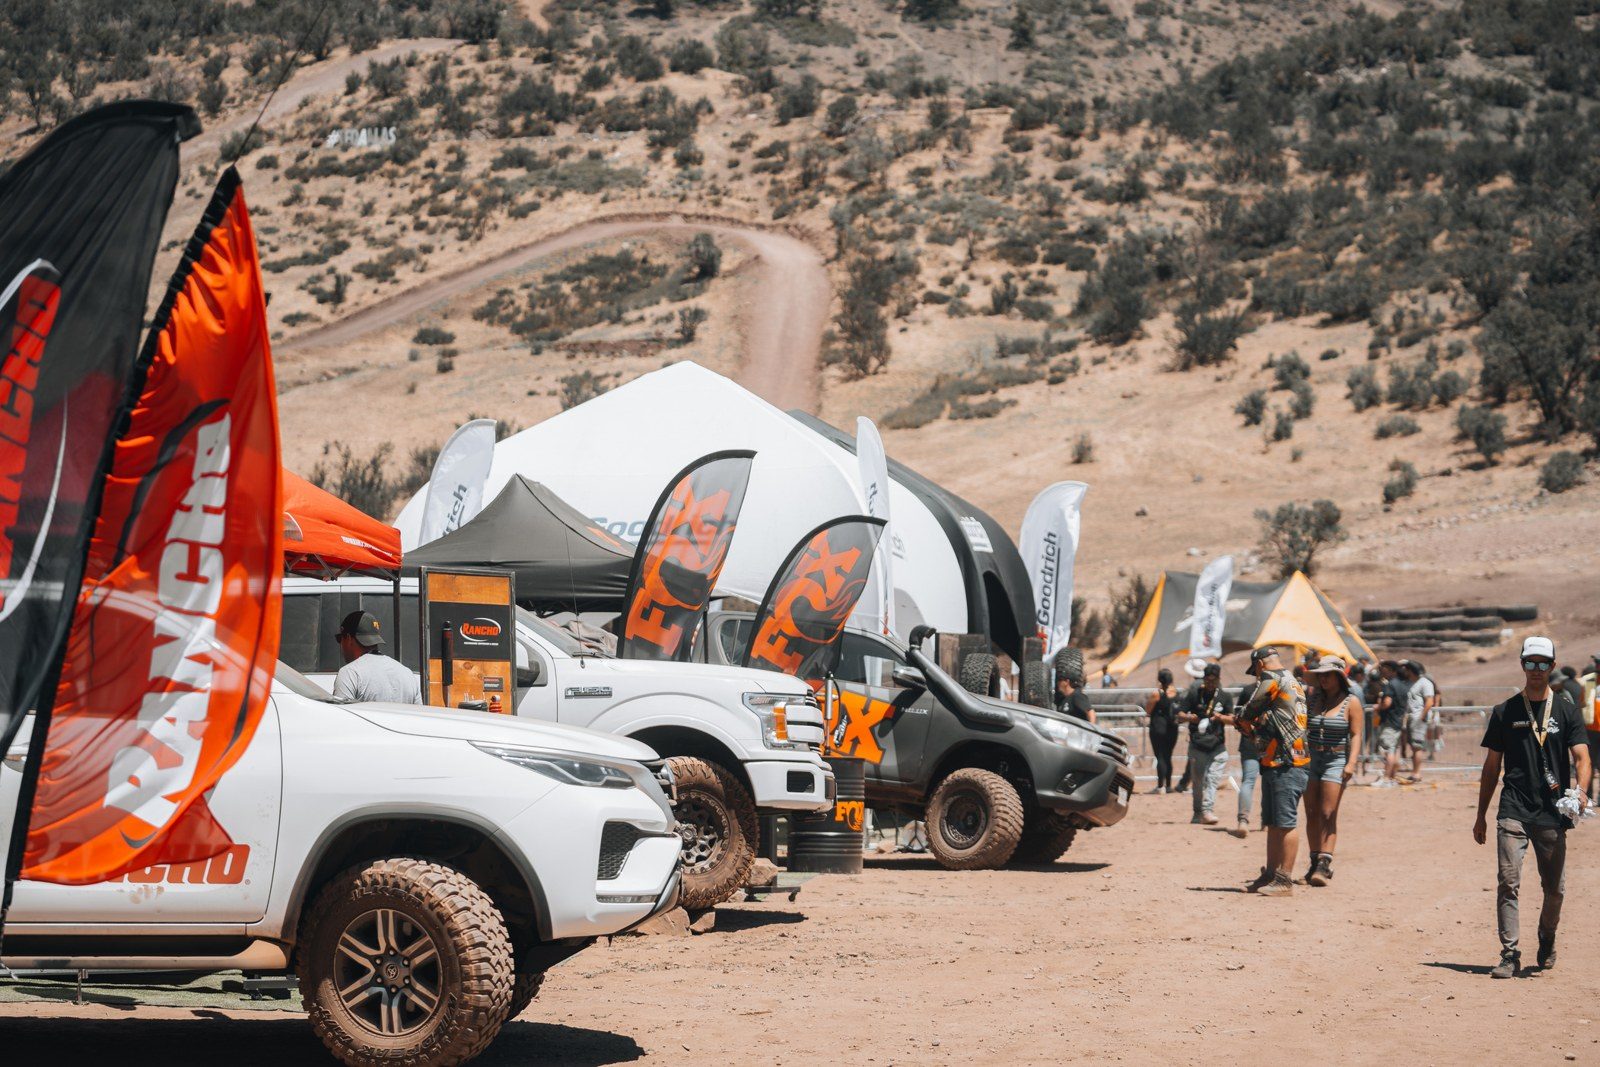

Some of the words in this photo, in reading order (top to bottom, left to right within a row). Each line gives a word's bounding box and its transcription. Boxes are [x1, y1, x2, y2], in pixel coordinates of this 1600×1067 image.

[442, 483, 468, 537] rich
[625, 475, 736, 657] FOX
[751, 529, 868, 676] FOX
[462, 622, 499, 636] RANCHO
